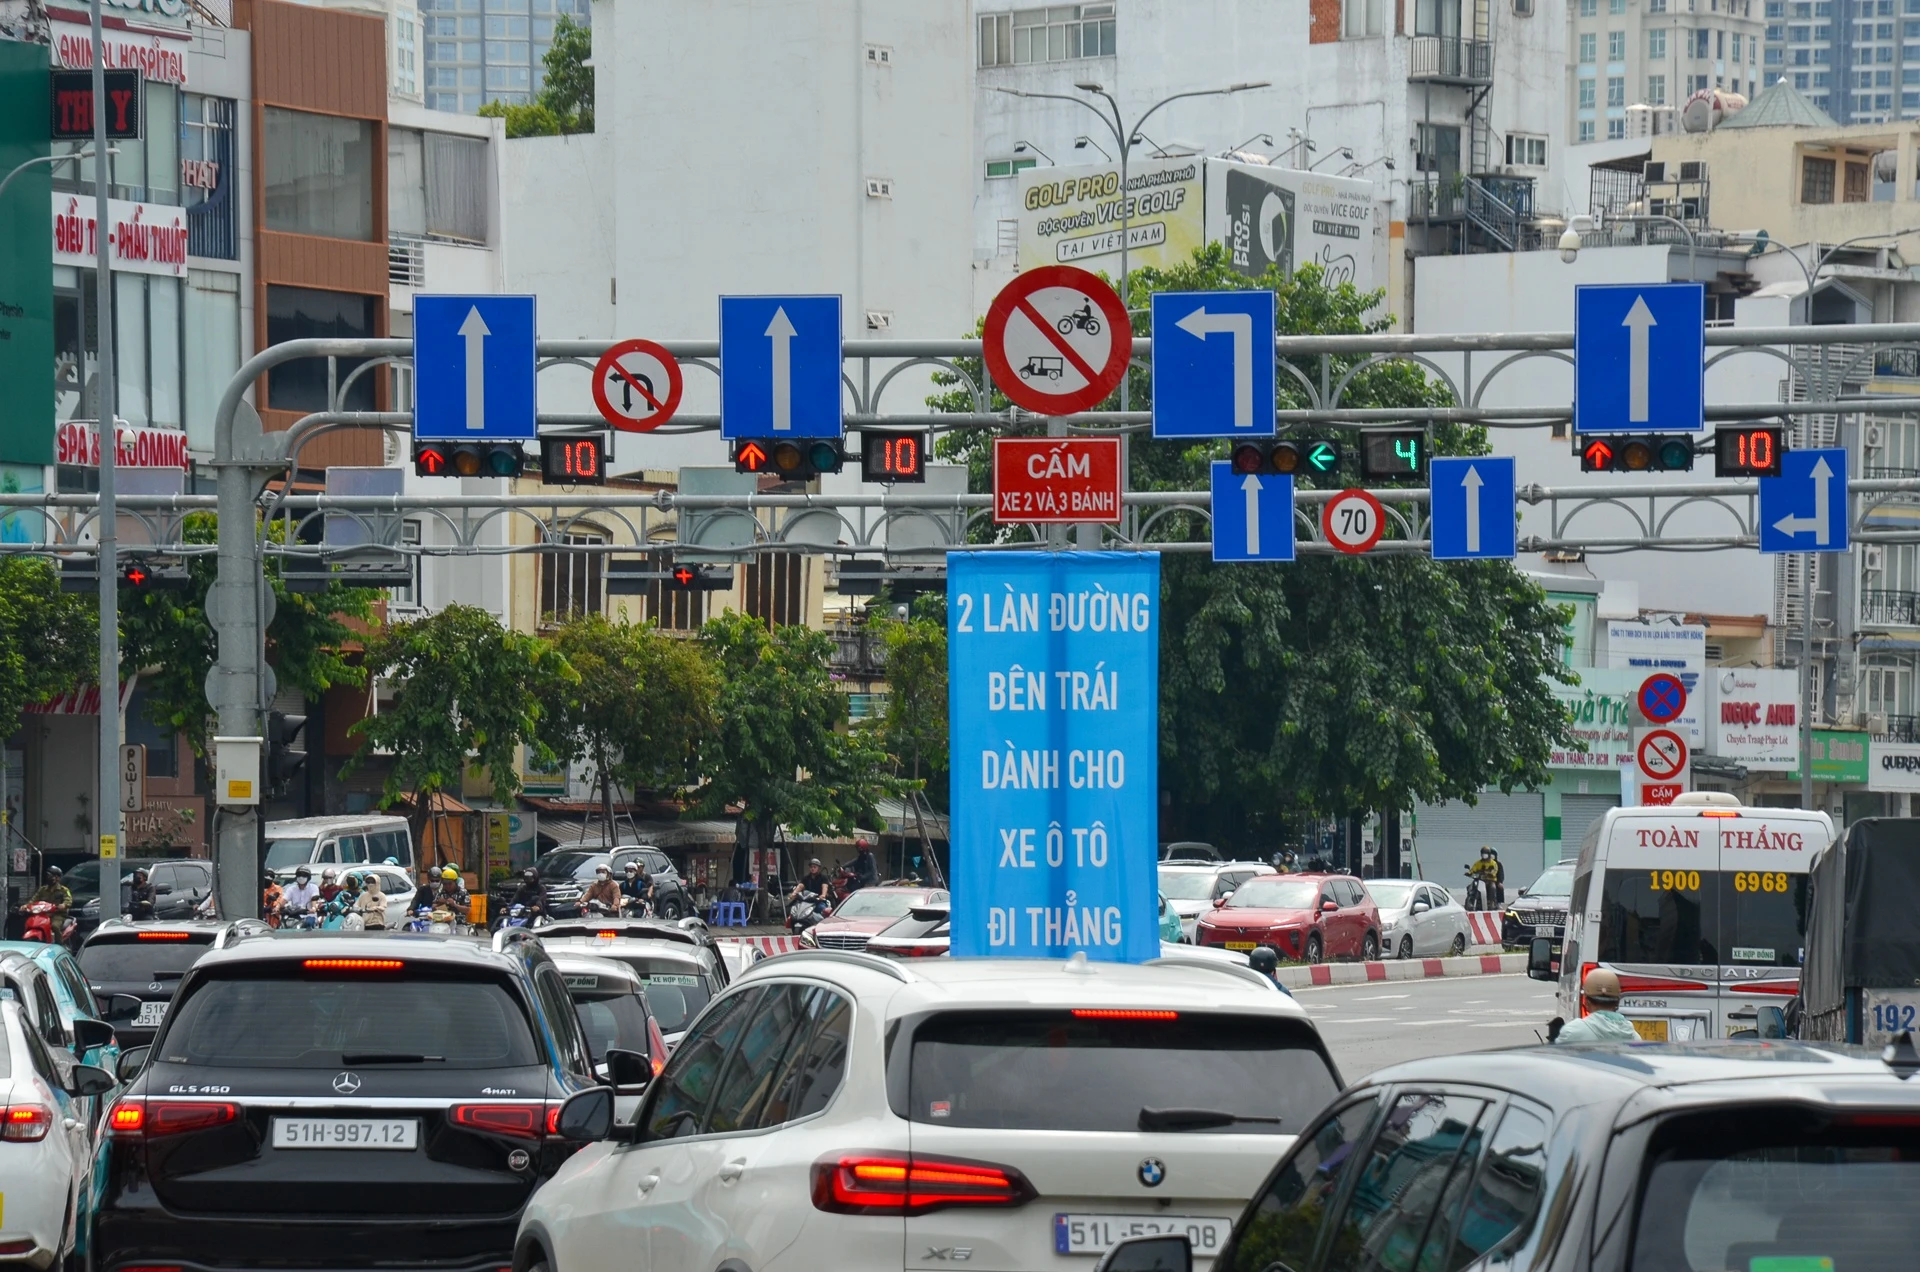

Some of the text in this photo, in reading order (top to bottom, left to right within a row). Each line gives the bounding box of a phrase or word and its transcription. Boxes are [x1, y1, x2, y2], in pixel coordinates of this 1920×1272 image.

[1025, 179, 1075, 210] GOLF
[1077, 171, 1118, 201] PRO
[1038, 217, 1060, 236] ĐỘC
[1138, 188, 1185, 216] GOLF
[1330, 202, 1348, 217] VICE
[1349, 205, 1369, 220] GOLF
[56, 197, 83, 253] ĐIỀU
[151, 216, 188, 274] THUẬT
[1063, 227, 1161, 258] TẠI VIỆT NAM
[1233, 220, 1242, 265] PRO
[58, 423, 88, 464] SPA
[564, 441, 596, 476] 10
[884, 438, 915, 474] 10
[1027, 442, 1090, 479] CẤM
[1395, 440, 1416, 470] 4
[1739, 431, 1772, 468] 10
[1001, 485, 1114, 512] XE 2 VÀ 3 BÁNH
[1341, 509, 1367, 535] 70
[957, 582, 1150, 633] 2 LÀN ĐƯỜNG
[989, 661, 1118, 711] BÊN TRÁI
[1721, 702, 1796, 729] NGỌC ANH
[982, 740, 1125, 789] DÀNH CHO
[999, 821, 1108, 868] XE Ô TÔ
[1636, 824, 1804, 851] TOÀN THẮNG
[1650, 870, 1788, 892] 1900 6968
[987, 889, 1122, 946] ĐI THẲNG
[137, 1014, 164, 1024] 051.
[145, 1004, 165, 1014] 51K
[169, 1085, 231, 1094] GLS 450
[286, 1123, 404, 1143] 51H-997.12
